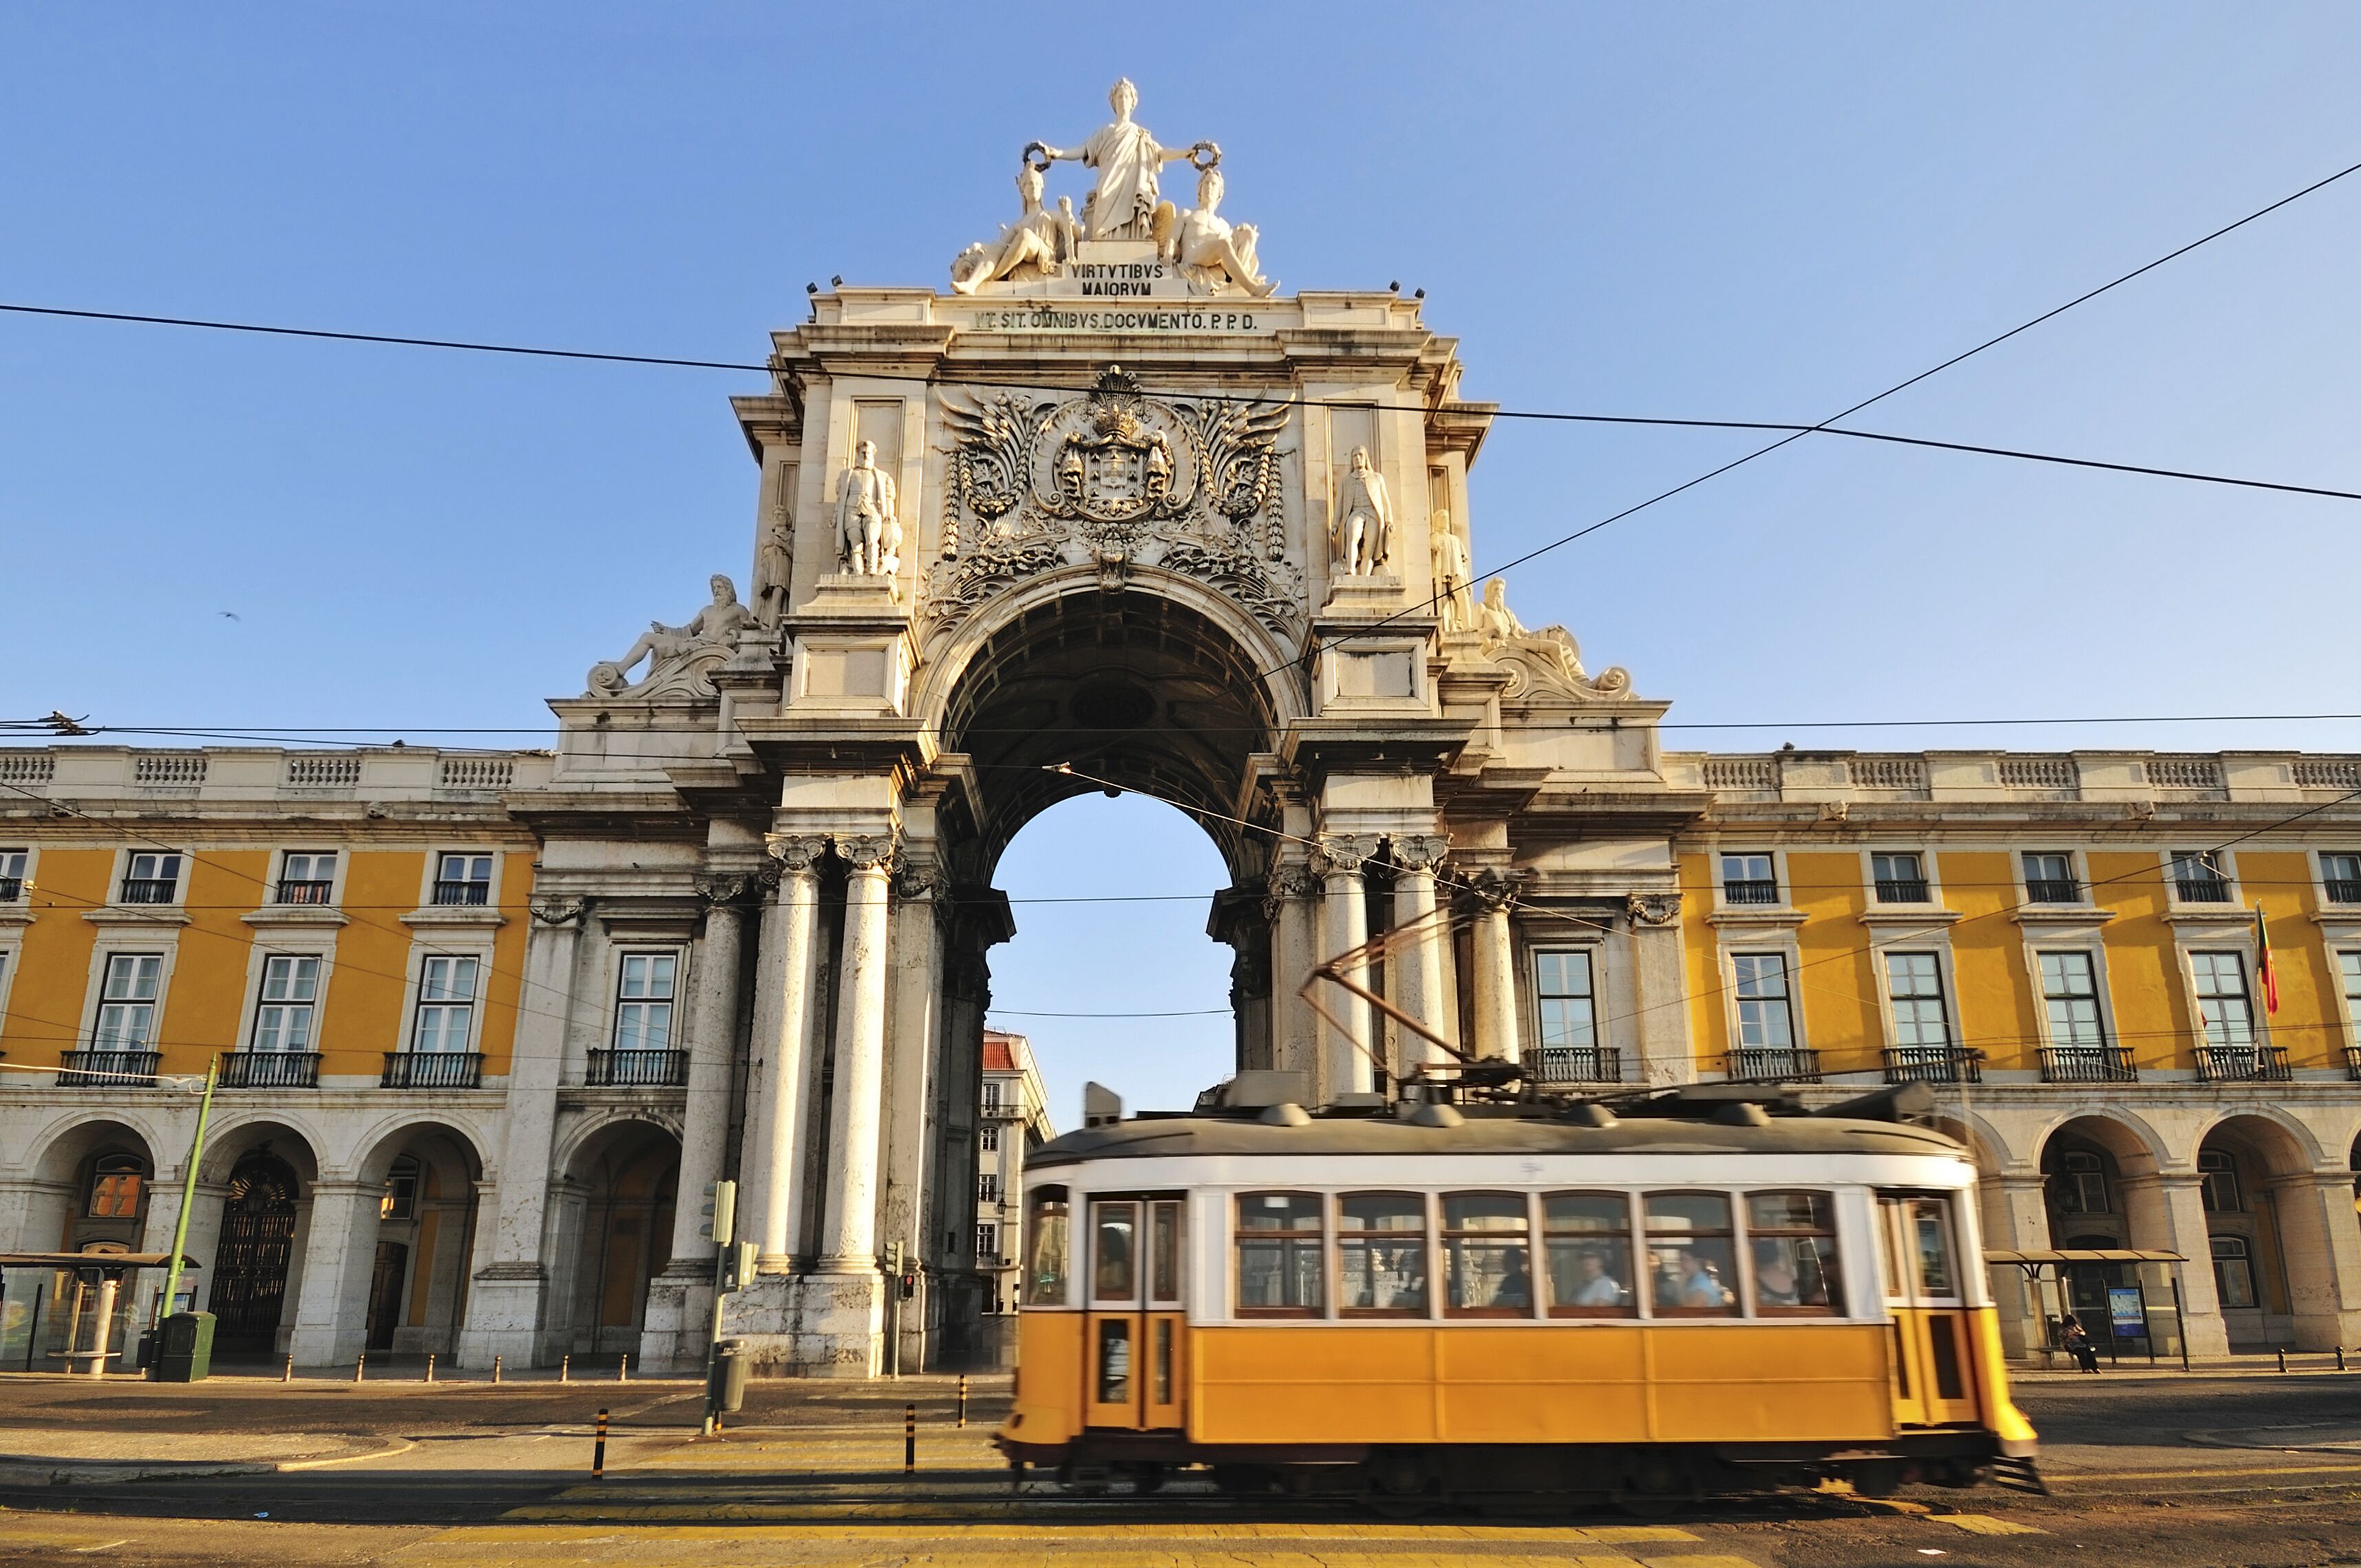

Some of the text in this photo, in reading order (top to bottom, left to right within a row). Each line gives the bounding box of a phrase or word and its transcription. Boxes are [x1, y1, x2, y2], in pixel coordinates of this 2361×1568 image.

[1071, 264, 1163, 278] VIRTVTIBVS
[1082, 282, 1151, 296] MAIORVM
[1001, 312, 1026, 328] SIT.
[1242, 315, 1258, 329] D.
